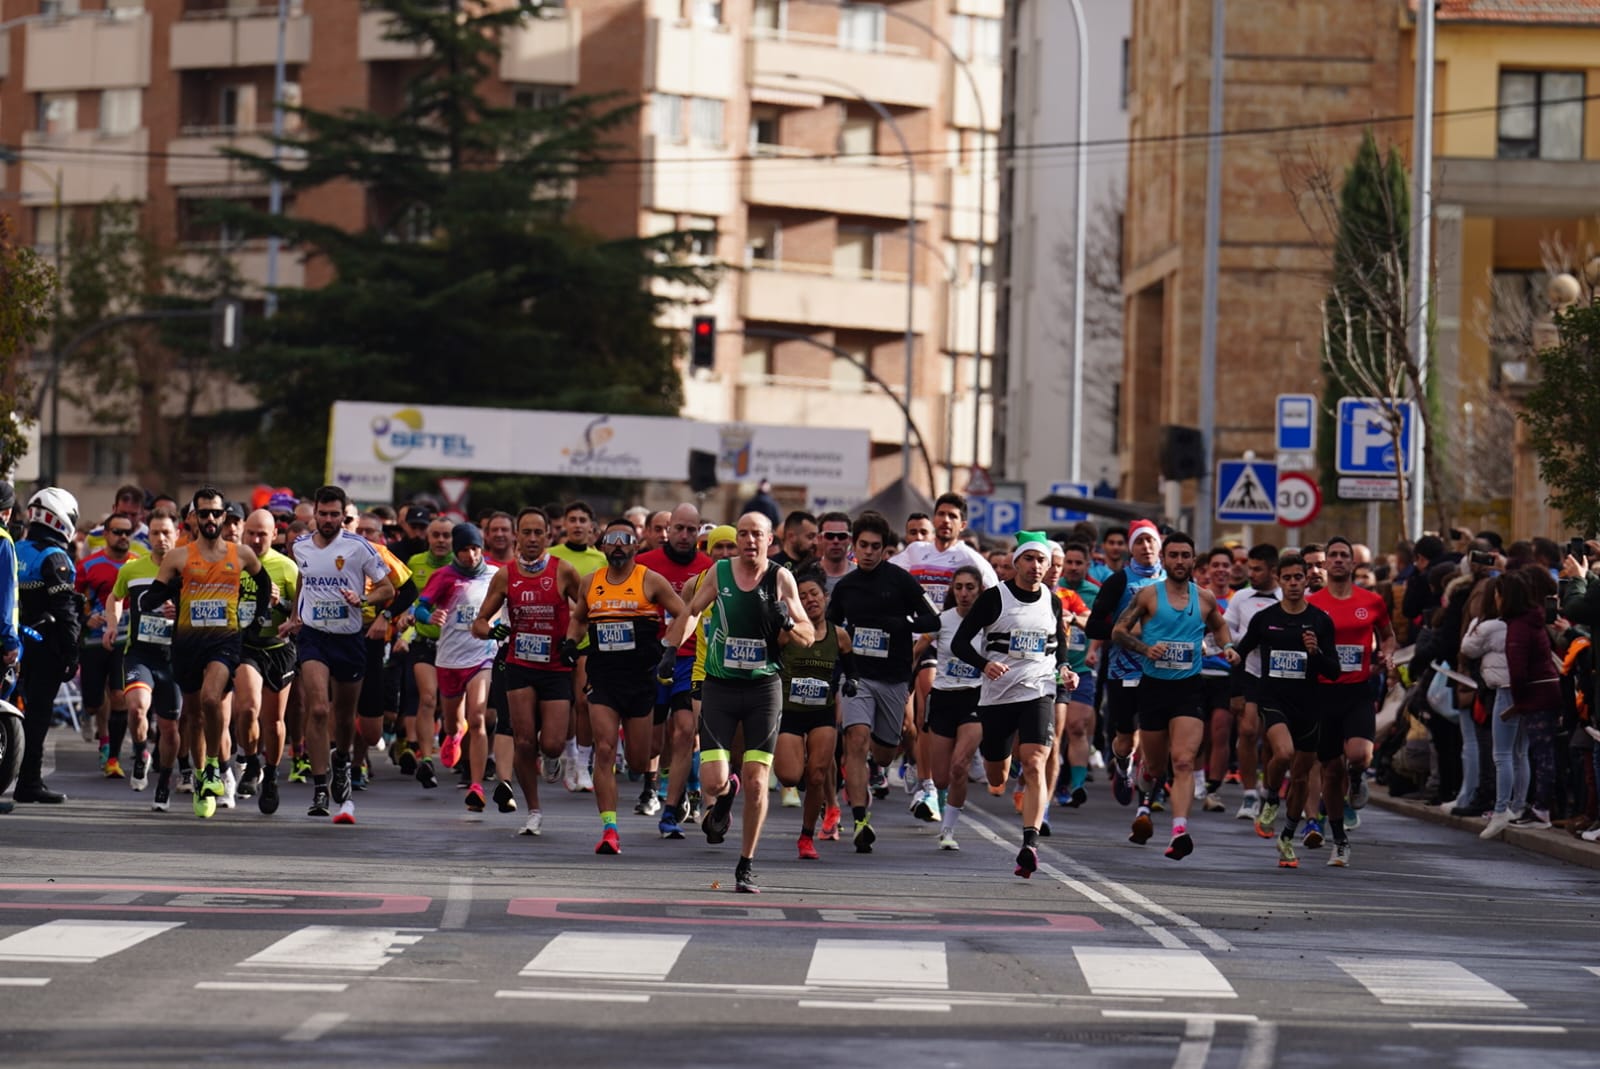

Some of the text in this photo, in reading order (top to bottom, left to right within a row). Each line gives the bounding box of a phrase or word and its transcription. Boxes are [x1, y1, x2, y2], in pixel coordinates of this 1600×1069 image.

[1351, 407, 1394, 466] P
[1279, 491, 1308, 508] 30
[992, 504, 1015, 533] P
[303, 576, 349, 586] ARAVAN
[605, 599, 639, 609] TEAM
[195, 607, 219, 618] 3423
[316, 607, 340, 618] 3433
[143, 623, 165, 636] 3422
[602, 630, 624, 642] 3401
[519, 640, 542, 653] 3429
[856, 634, 881, 648] 3469
[1014, 637, 1039, 650] 3408
[731, 646, 756, 660] 3414
[1163, 649, 1184, 661] 3413
[1274, 657, 1298, 670] 3403
[950, 664, 975, 677] 4852
[795, 683, 820, 697] 3489
